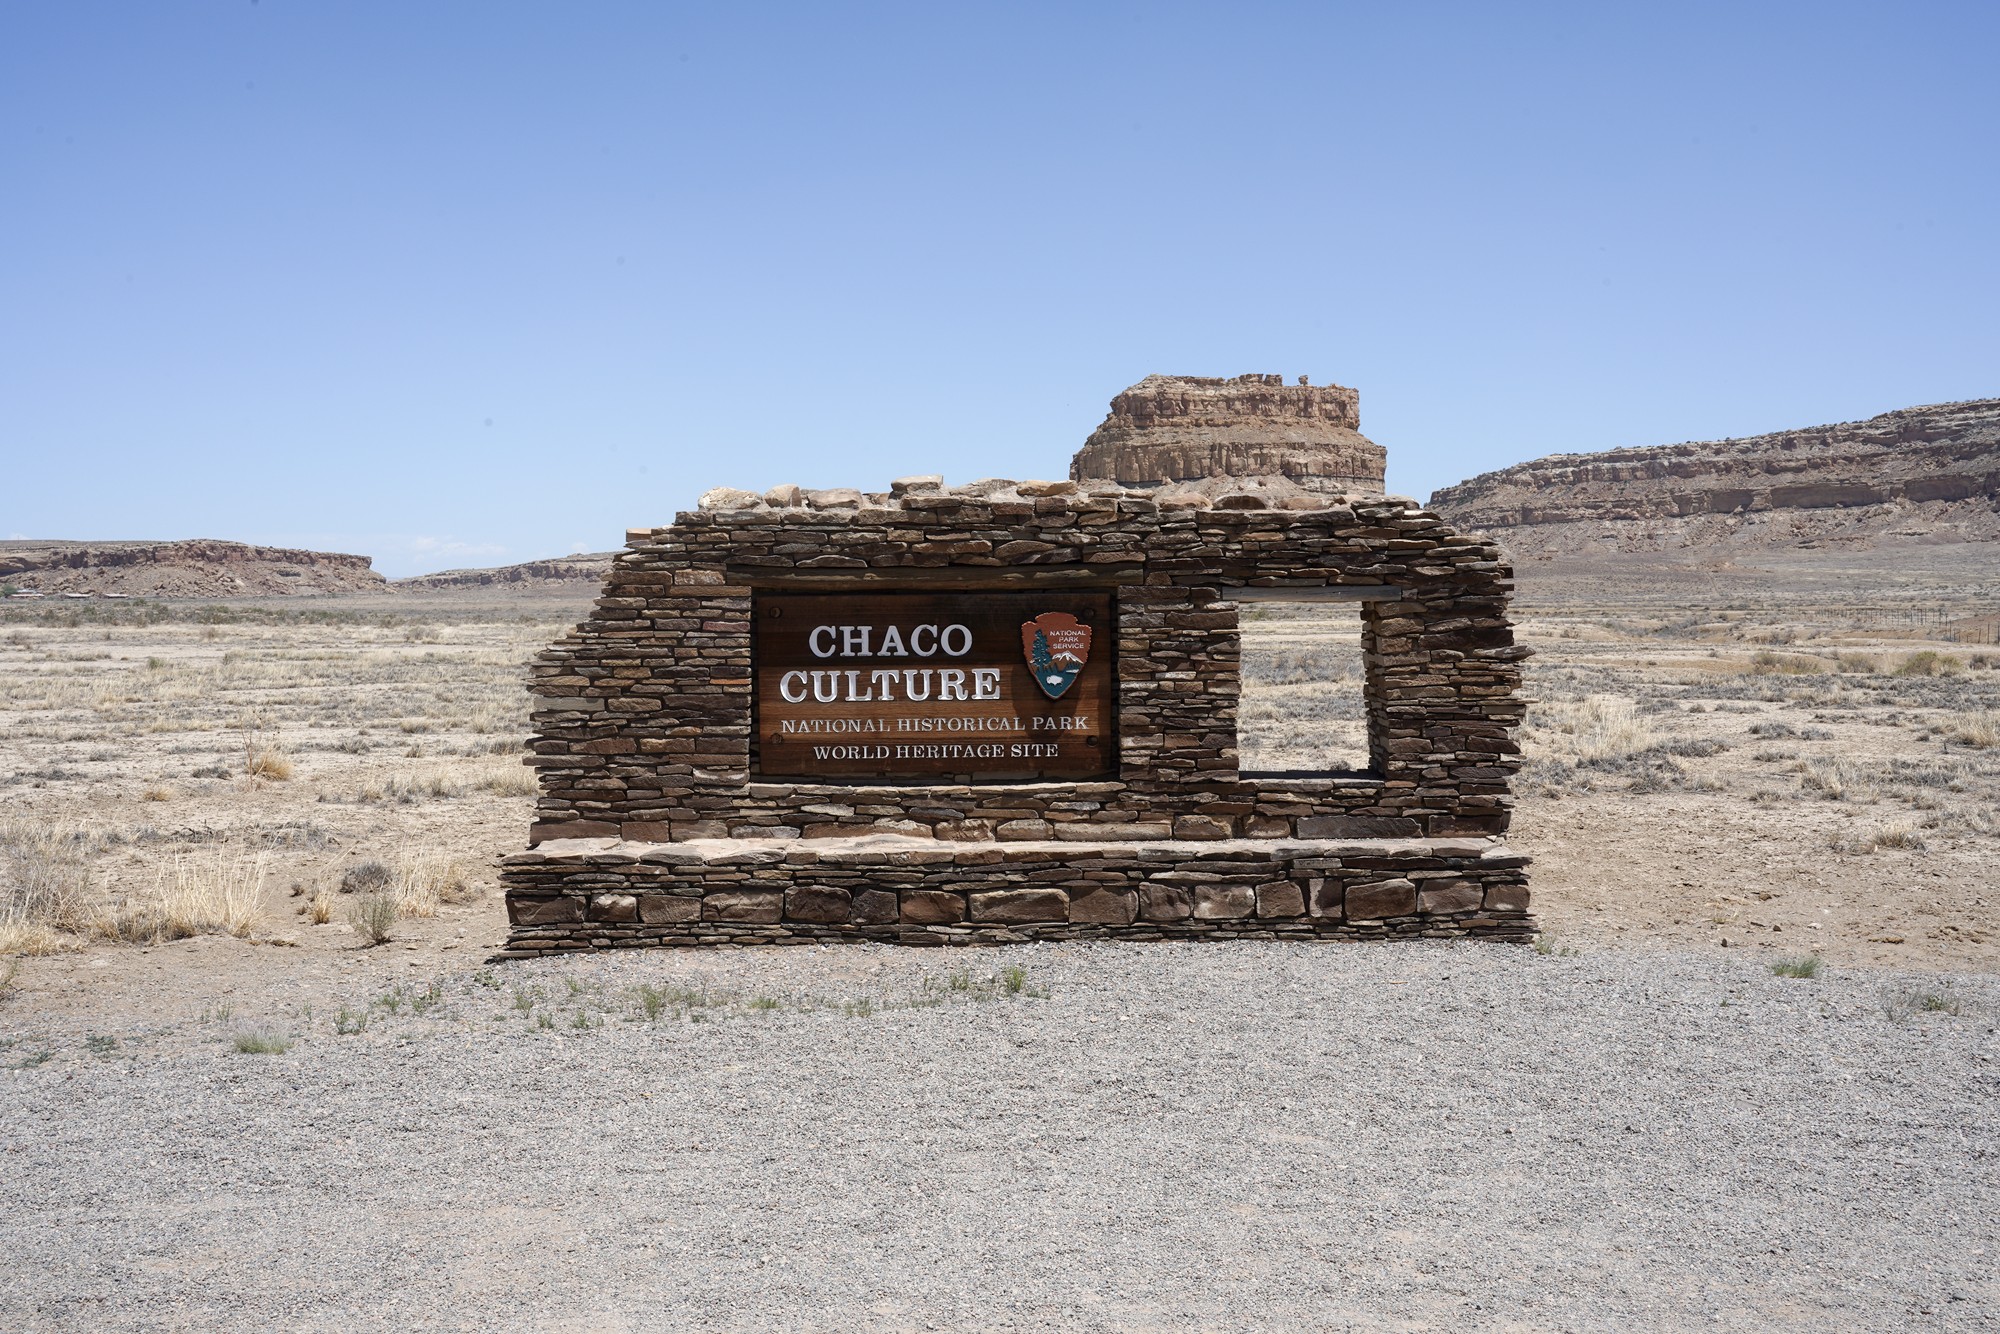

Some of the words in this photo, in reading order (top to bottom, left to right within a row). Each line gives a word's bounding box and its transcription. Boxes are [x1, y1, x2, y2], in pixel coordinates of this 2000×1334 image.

[808, 624, 973, 658] CHACO
[779, 668, 1001, 703] CULTURE
[780, 719, 891, 733] NATIONAL
[896, 717, 1026, 732] HISTORICAL
[1032, 716, 1089, 731] PARK
[813, 745, 890, 760] WORLD
[896, 744, 1005, 759] HERITAGE
[1010, 743, 1059, 758] SITE
